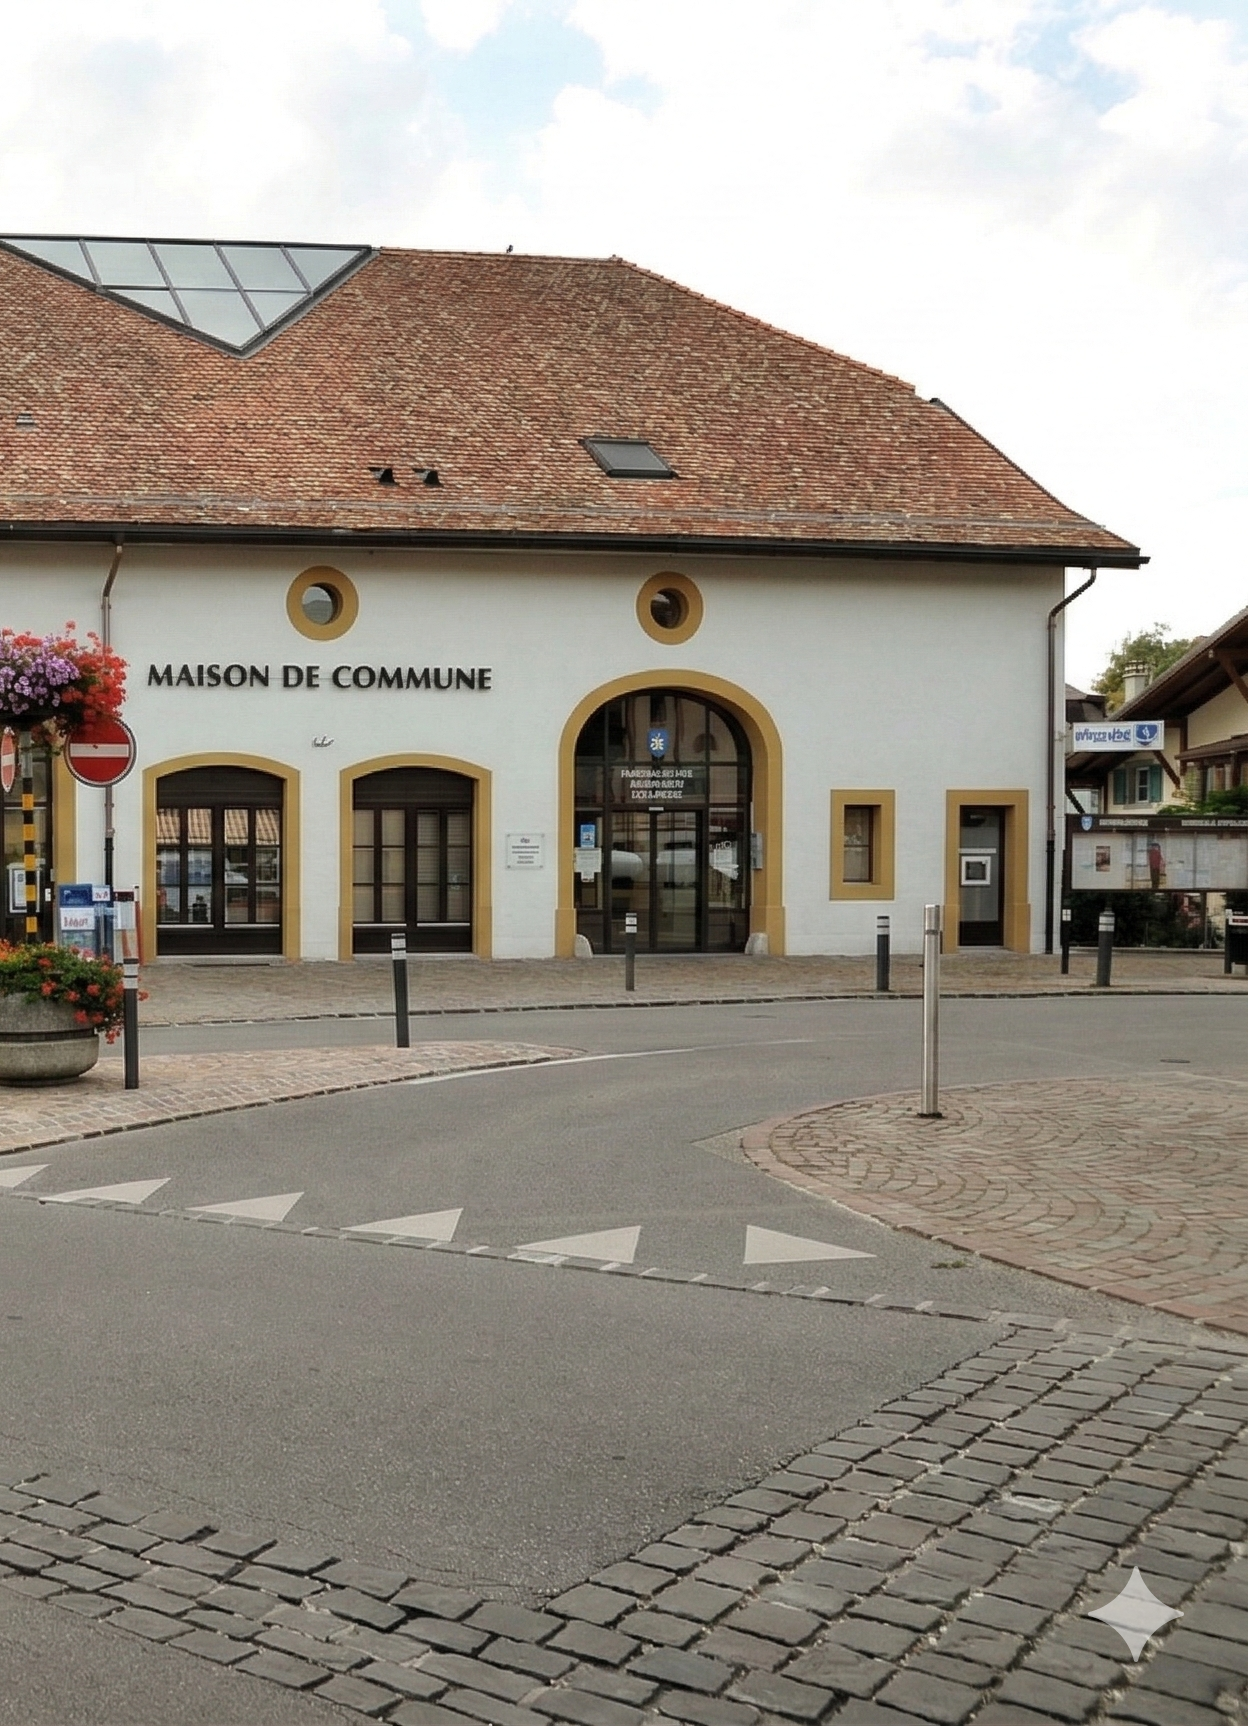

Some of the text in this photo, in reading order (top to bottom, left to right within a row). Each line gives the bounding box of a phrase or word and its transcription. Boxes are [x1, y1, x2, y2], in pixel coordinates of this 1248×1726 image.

[147, 664, 492, 690] MAISON DE COMMUNE
